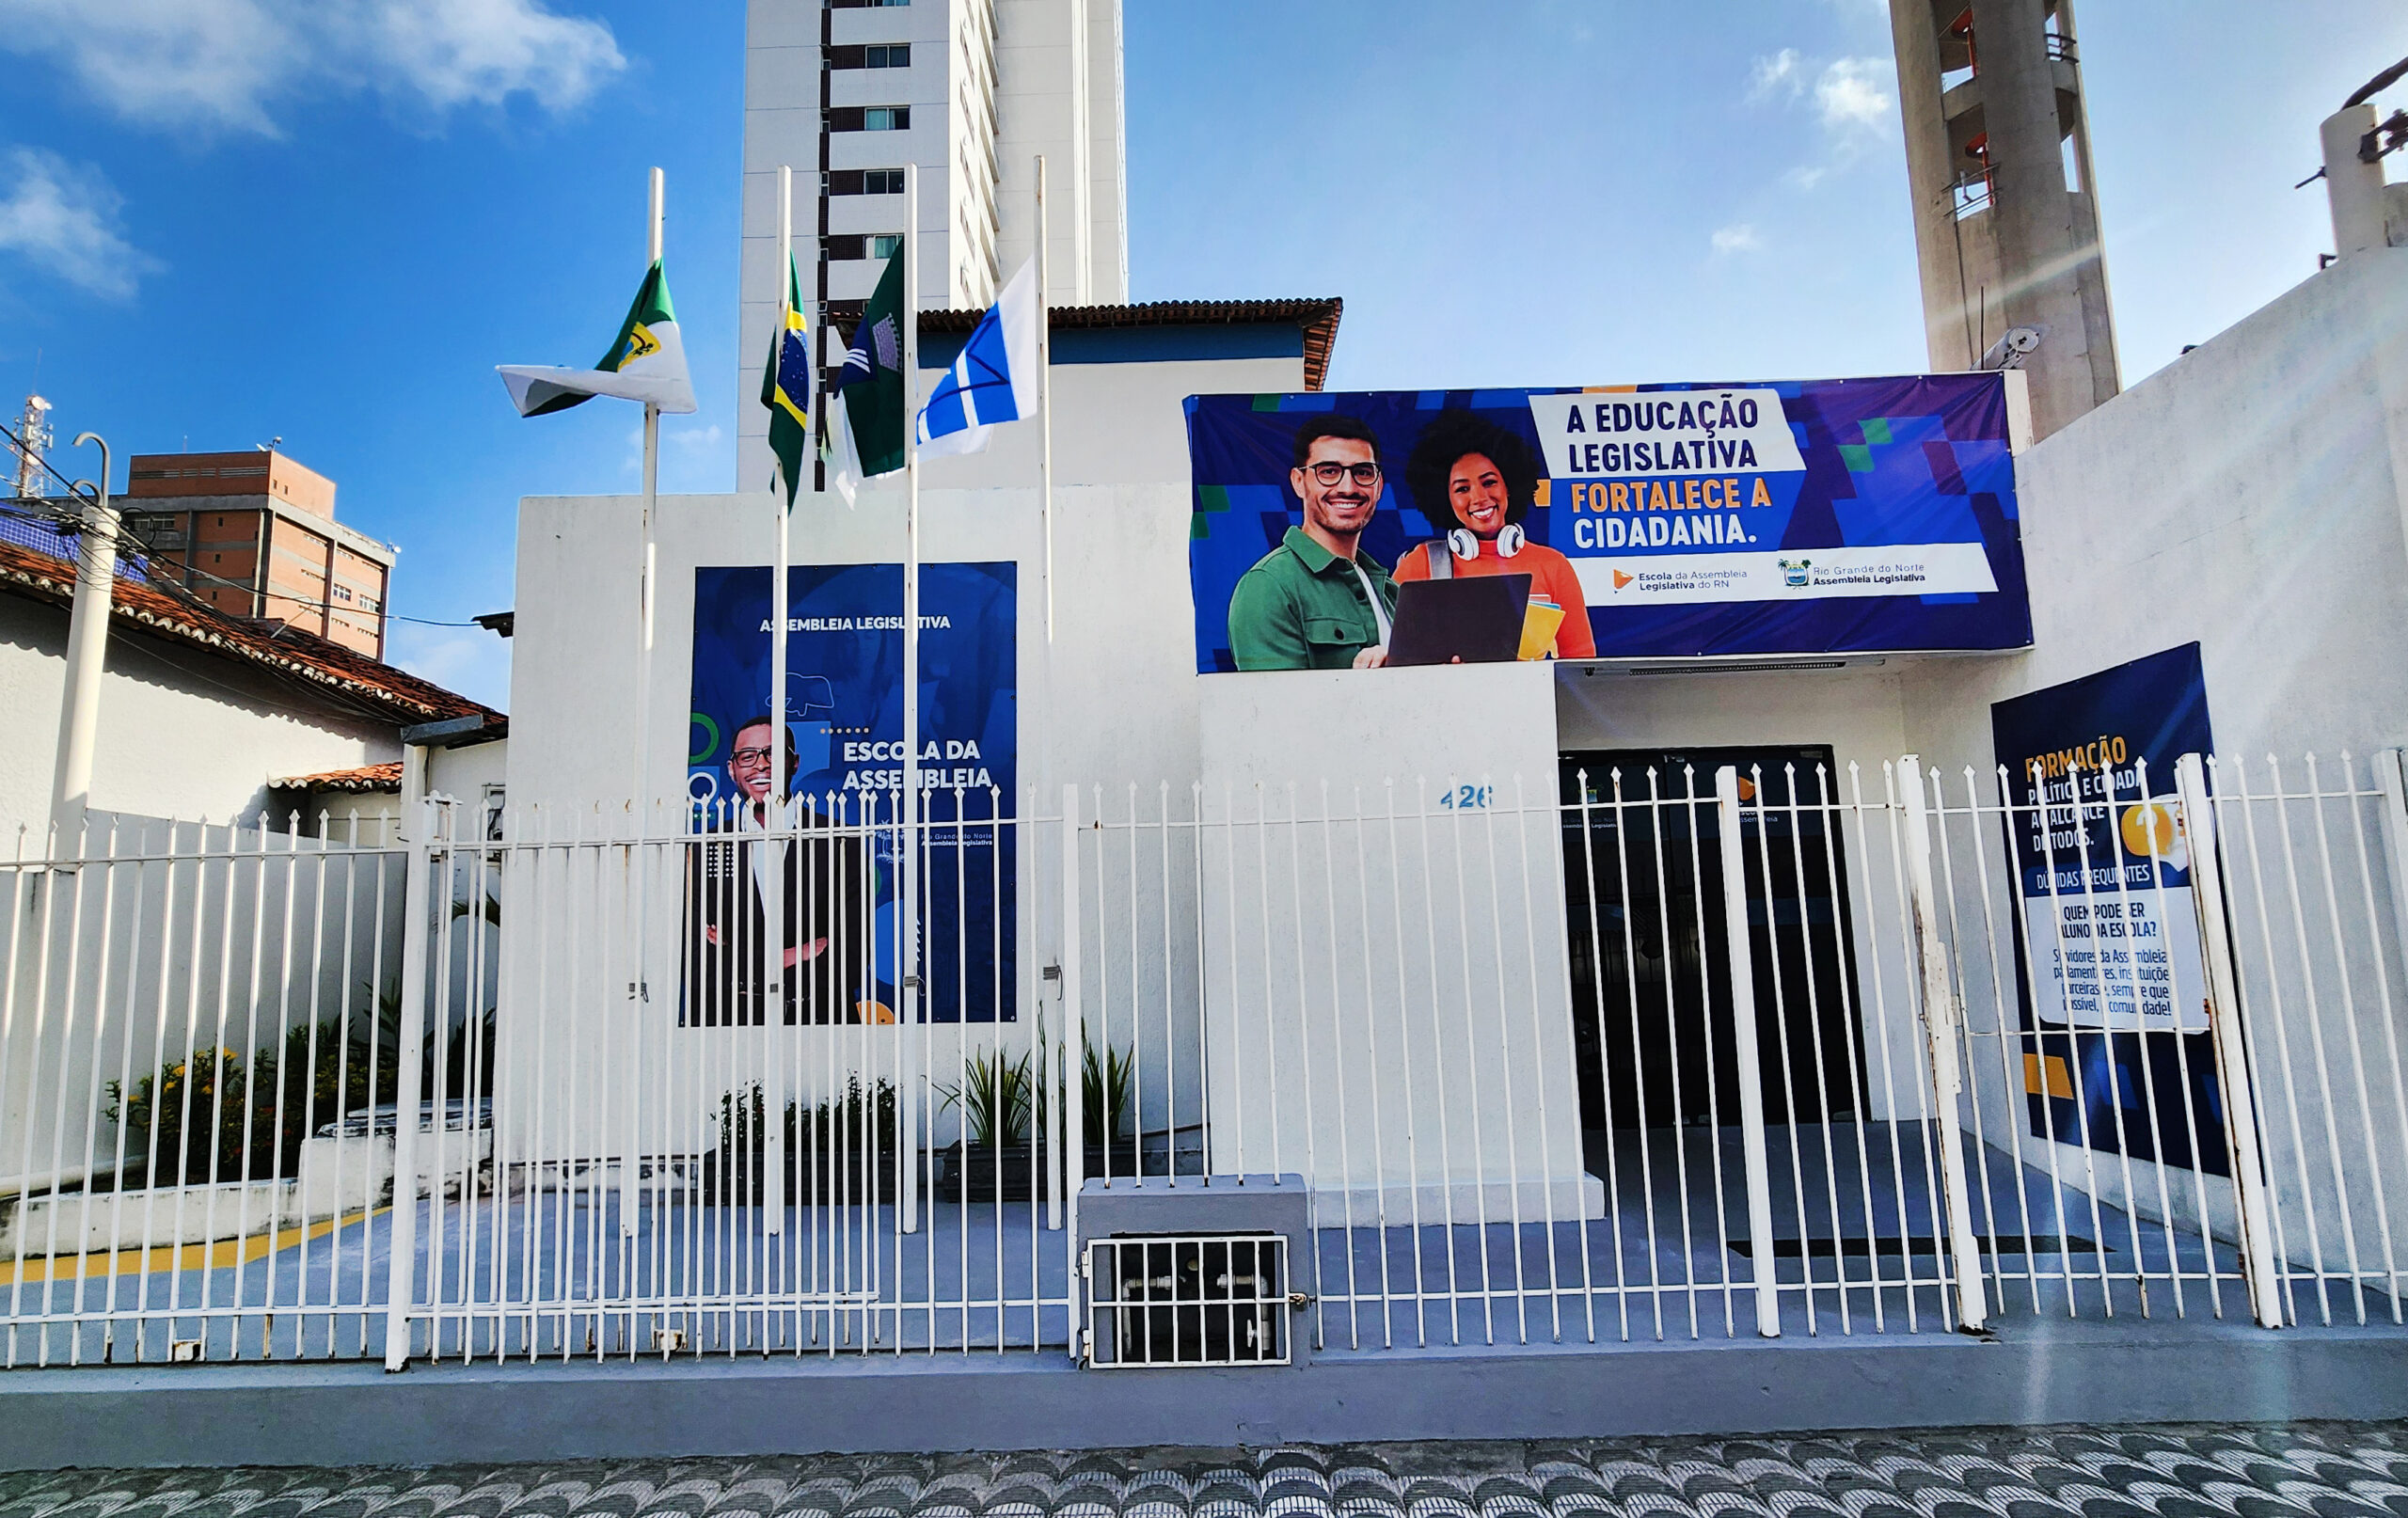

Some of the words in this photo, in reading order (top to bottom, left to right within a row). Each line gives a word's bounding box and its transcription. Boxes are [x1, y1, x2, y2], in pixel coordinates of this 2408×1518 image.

[1566, 404, 1586, 433] A
[1595, 393, 1758, 439] EDUCAÇÃO
[1569, 438, 1758, 472] LEGISLATIVA
[1571, 478, 1741, 514] FORTALECE
[1751, 477, 1772, 508] A
[1574, 514, 1757, 549] CIDADANIA.
[1639, 572, 1671, 580] Escola
[1674, 572, 1687, 580] da
[1690, 569, 1748, 579] Assembleia
[1814, 566, 1830, 575] Rio
[1833, 565, 1874, 575] Grande
[1877, 564, 1892, 573] do
[1814, 575, 1871, 585] Assembleia
[1874, 574, 1925, 584] Legislativa
[1640, 581, 1695, 592] Legislativa
[1698, 580, 1711, 589] do
[1714, 579, 1730, 588] RN
[759, 617, 853, 632] AEMBLEIA
[856, 616, 951, 630] LEGISLTIVA
[946, 740, 981, 760] DA
[2025, 735, 2127, 783] FORMAÇÃO
[842, 767, 992, 790] ASSEBLEIA
[1440, 784, 1493, 809] 426
[2028, 781, 2082, 806] PLÍTIC
[2083, 778, 2092, 797] E
[2036, 870, 2080, 890] DÚIDAS
[2094, 903, 2122, 919] PODE
[2128, 902, 2146, 918] ER
[2053, 949, 2097, 963] Svidores
[2113, 949, 2167, 963] Assmbleia
[2149, 986, 2170, 1000] que
[2109, 1001, 2172, 1016] comudade!
